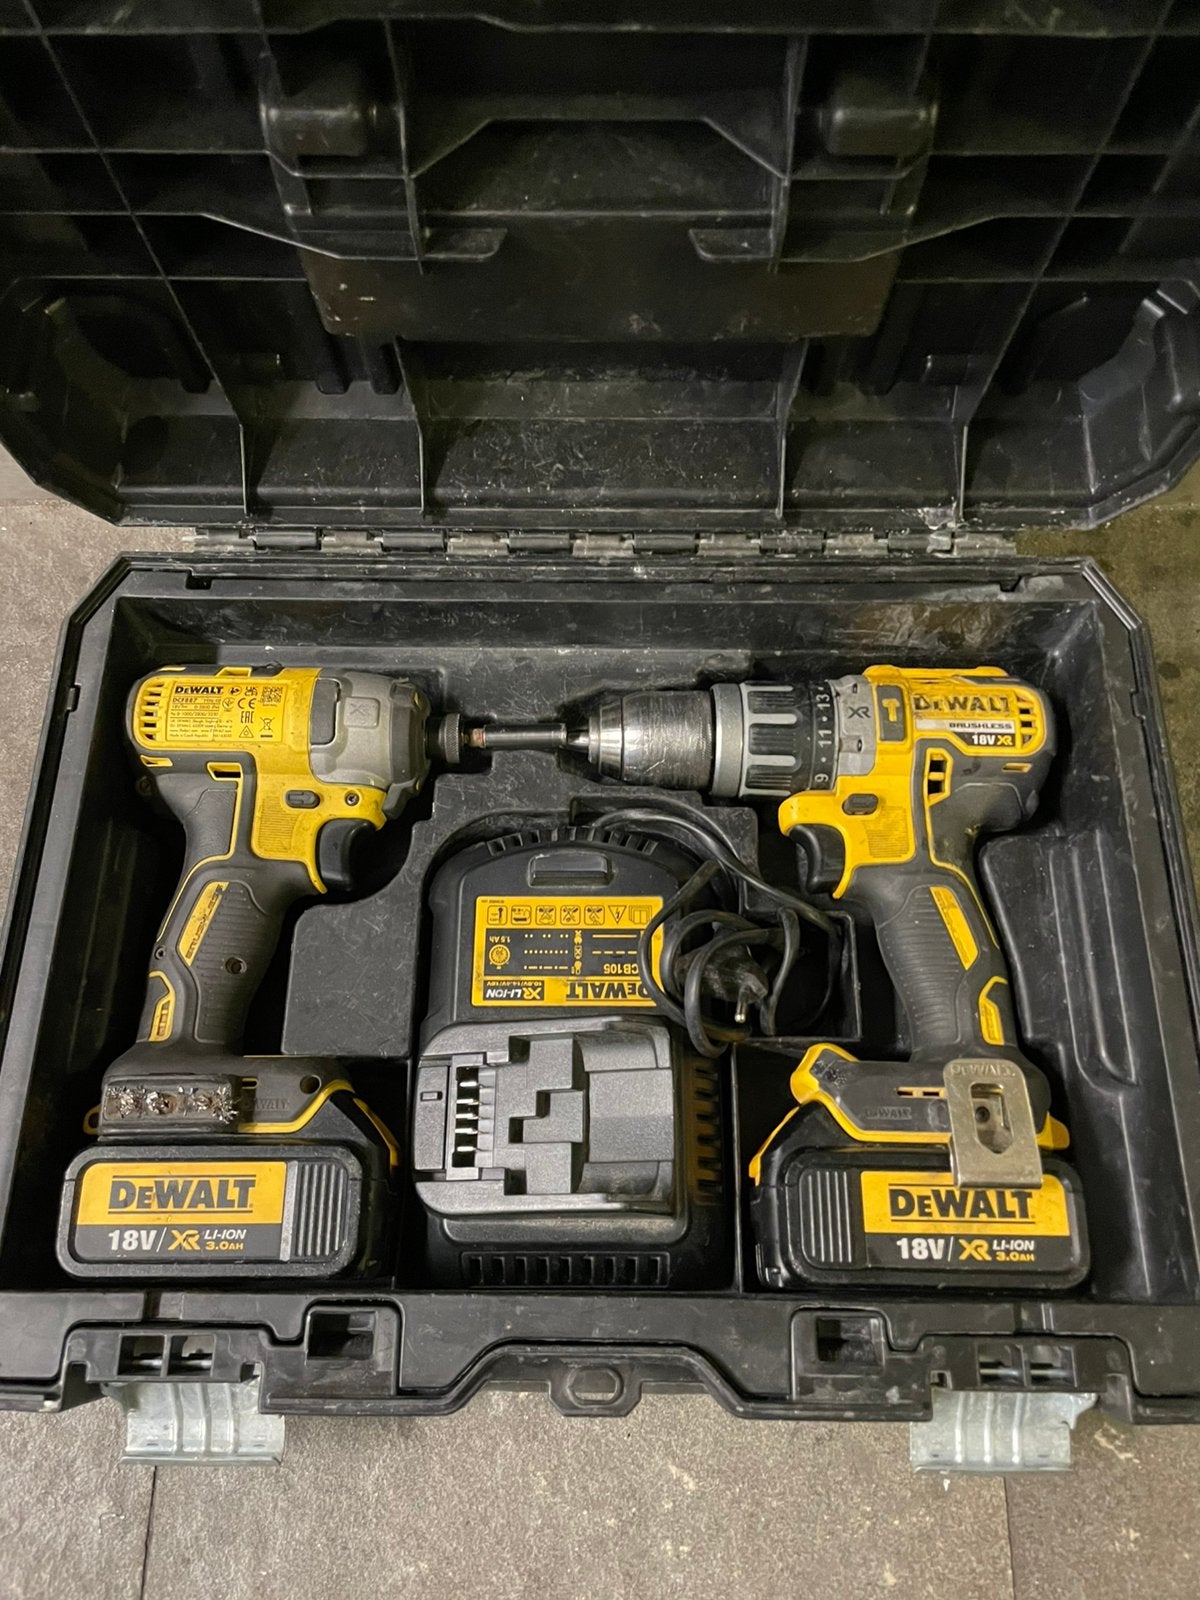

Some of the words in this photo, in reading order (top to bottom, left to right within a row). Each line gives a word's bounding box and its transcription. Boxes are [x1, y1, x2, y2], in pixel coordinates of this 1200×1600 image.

[816, 694, 831, 710] 13
[848, 706, 871, 719] XR
[948, 722, 1013, 730] BRUSHLESS
[817, 730, 832, 748] 11
[972, 735, 995, 745] 18V
[996, 735, 1013, 746] XR
[814, 773, 829, 783] 9
[485, 988, 522, 998] LI-ION
[523, 987, 542, 999] XR
[203, 1228, 247, 1240] LI-ION
[992, 1239, 1035, 1251] LI-ION
